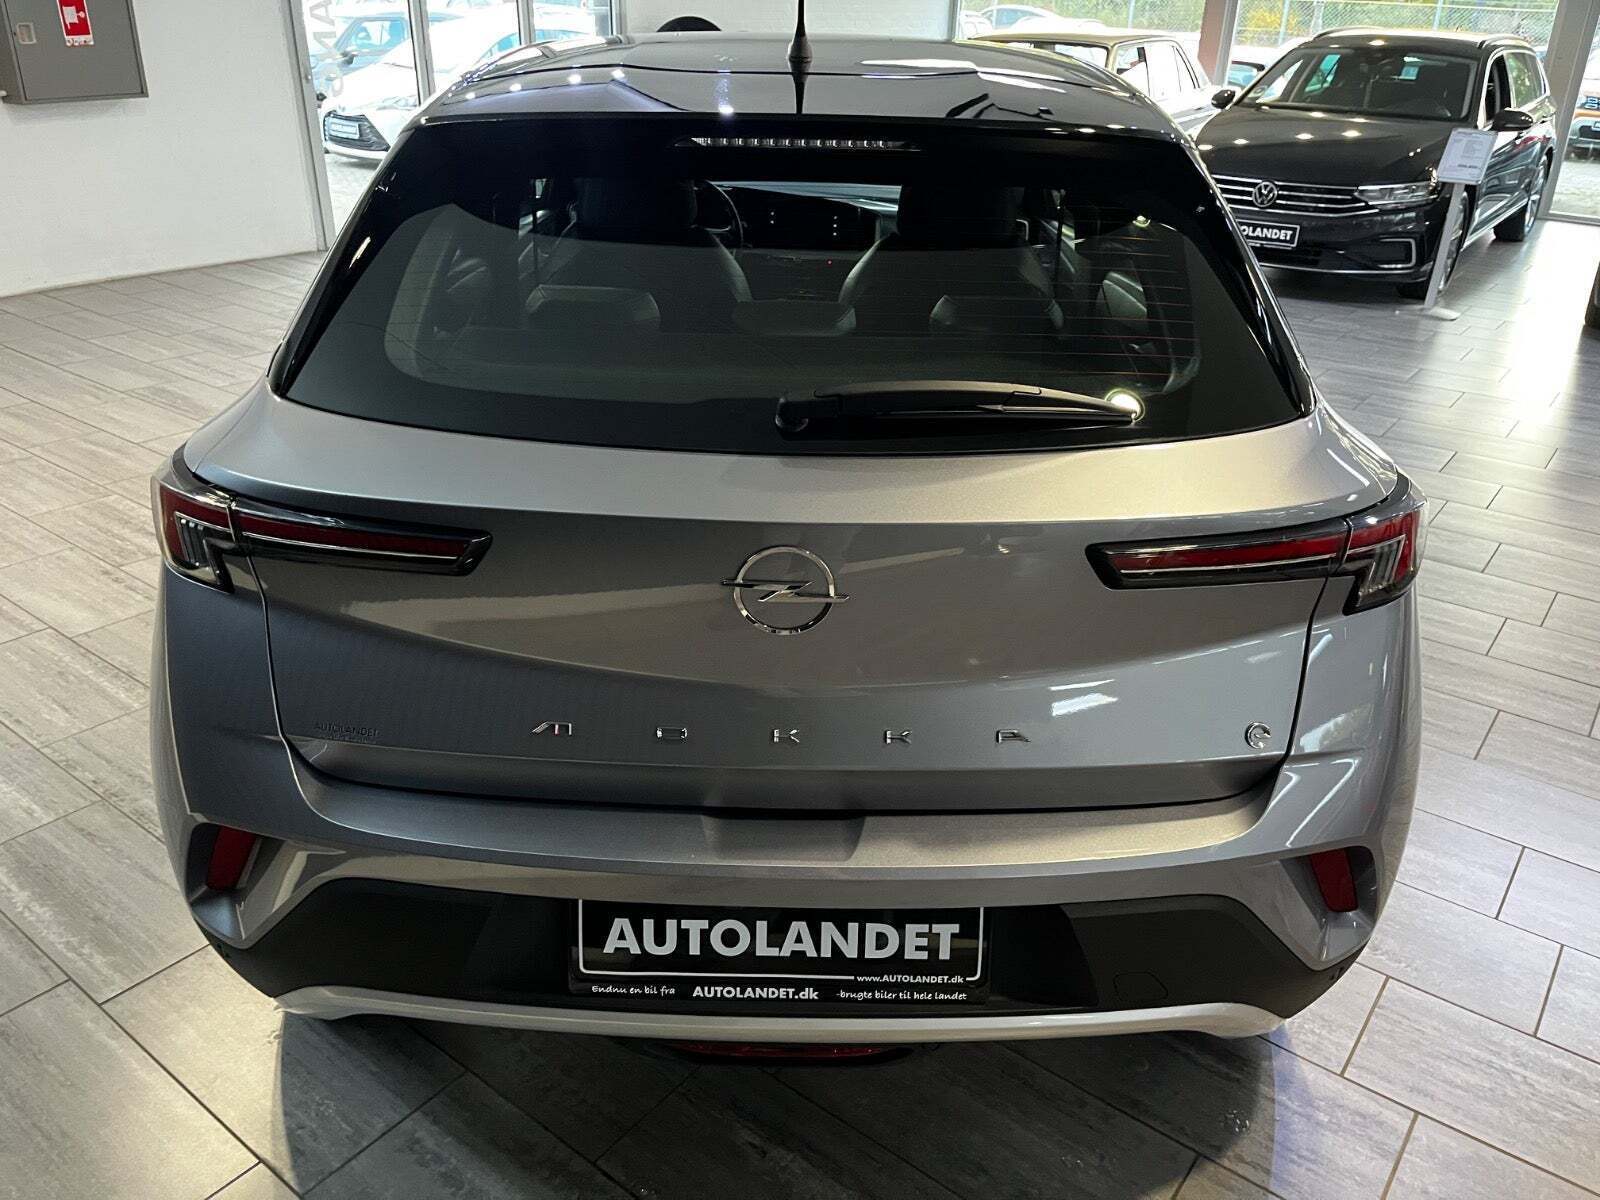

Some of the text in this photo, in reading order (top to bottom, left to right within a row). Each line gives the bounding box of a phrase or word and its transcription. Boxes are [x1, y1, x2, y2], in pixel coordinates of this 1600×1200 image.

[603, 917, 960, 960] AUTOLANDET
[857, 974, 964, 984] www.AUTOLANDET.dk
[591, 985, 627, 993] Endnu
[644, 985, 658, 994] bil
[660, 985, 675, 996] fra
[692, 985, 819, 1000] AUTOLANDET.dk
[875, 990, 897, 1000] biler
[899, 990, 911, 1000] til
[913, 991, 932, 1000] hele
[934, 991, 968, 1000] landet
